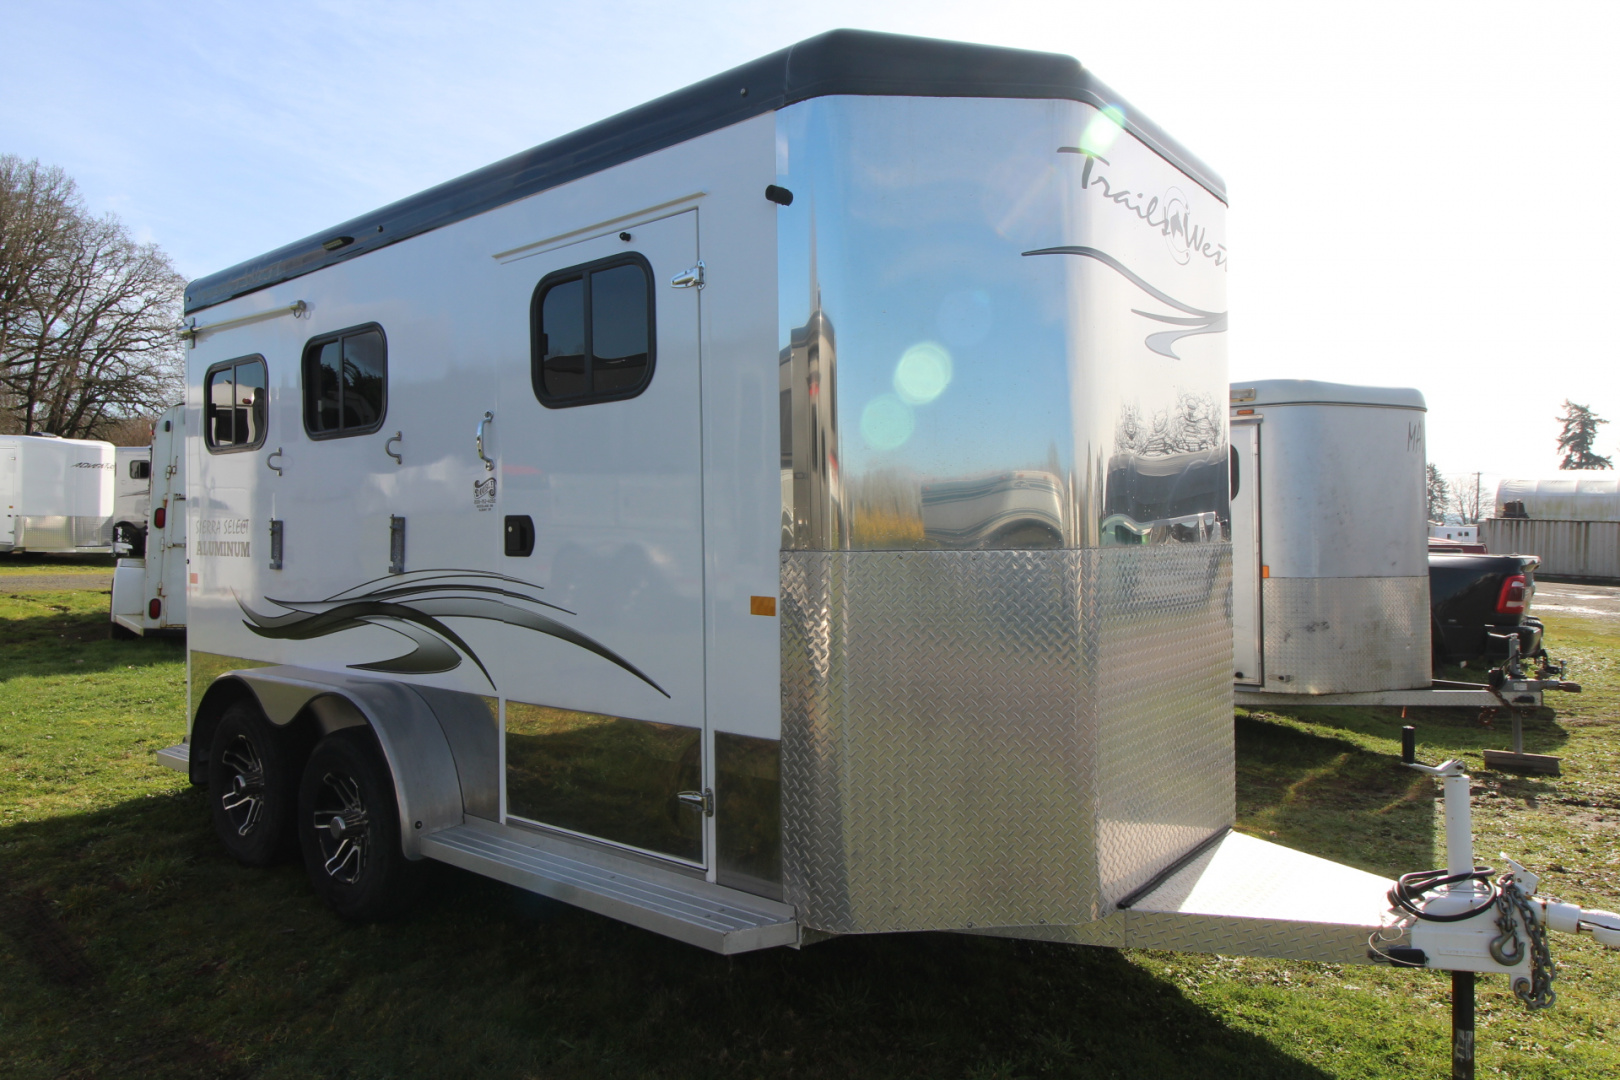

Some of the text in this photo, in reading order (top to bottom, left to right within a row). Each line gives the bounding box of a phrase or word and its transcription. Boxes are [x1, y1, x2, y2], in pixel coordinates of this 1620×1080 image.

[195, 519, 249, 535] SIERRA SELECT
[196, 541, 251, 557] ALUMINUM
